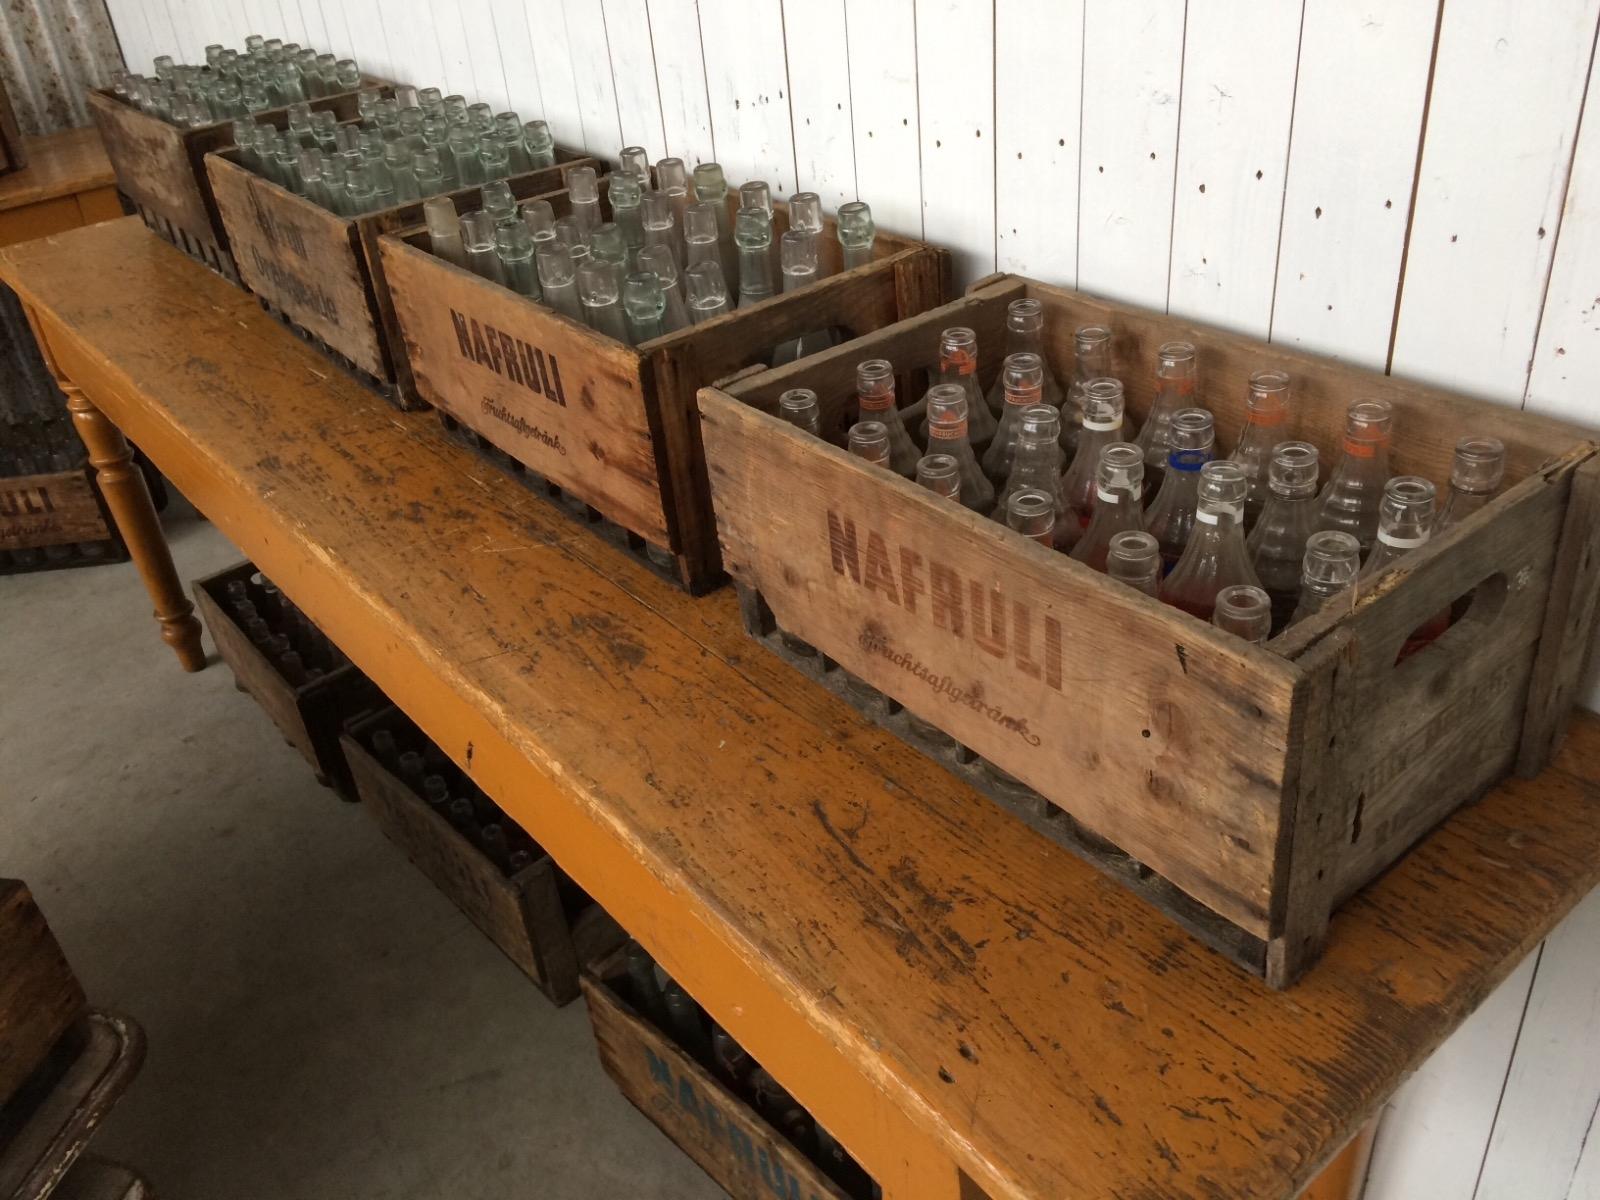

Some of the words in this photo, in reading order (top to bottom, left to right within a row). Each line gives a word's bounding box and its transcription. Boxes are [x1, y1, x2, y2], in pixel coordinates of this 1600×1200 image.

[450, 307, 567, 408] NAFRULI
[827, 508, 1062, 692] NAFRULI
[644, 1046, 822, 1200] NAFRU
